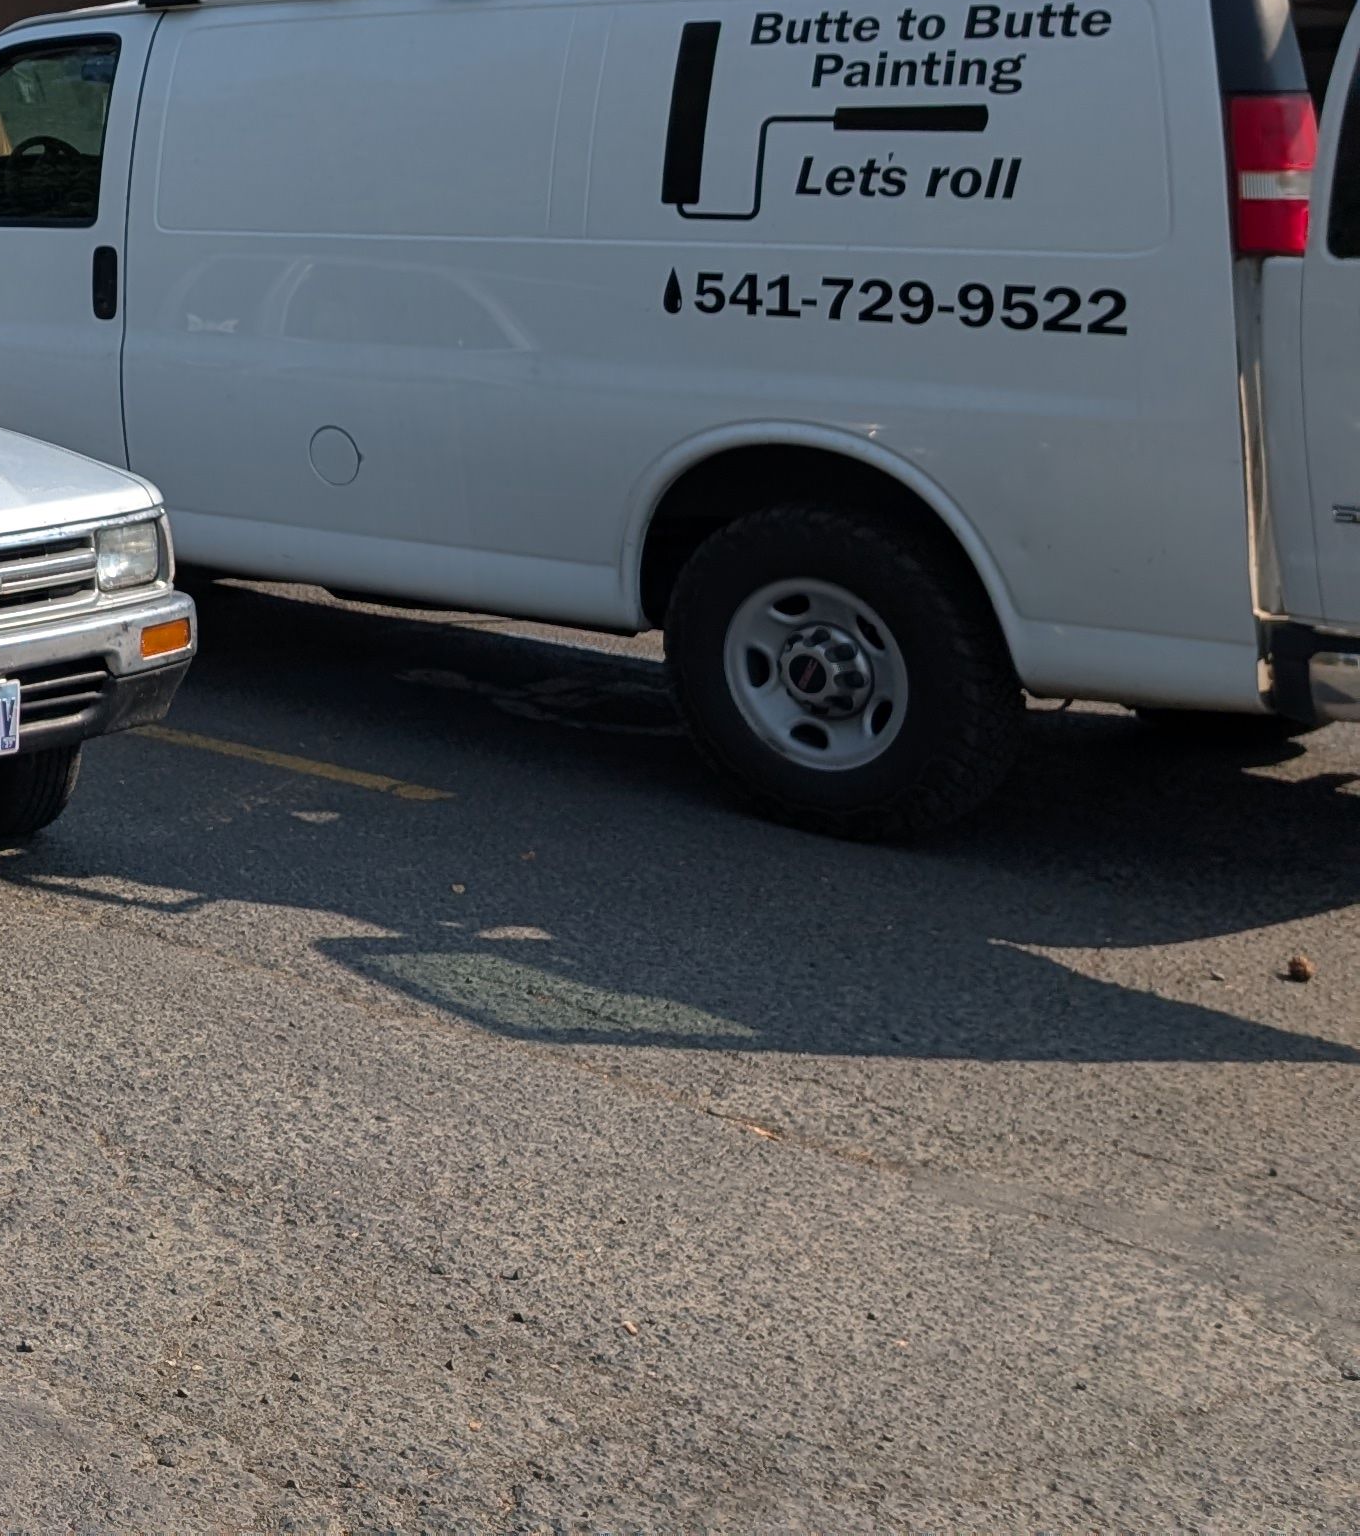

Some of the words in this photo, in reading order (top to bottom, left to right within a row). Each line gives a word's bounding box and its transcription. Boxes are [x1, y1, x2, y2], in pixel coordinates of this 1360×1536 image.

[750, 10, 880, 45] Butte
[897, 7, 946, 42] to
[963, 2, 1113, 40] Butte
[811, 49, 1027, 94] Painting
[794, 152, 908, 198] Let's
[925, 157, 1023, 199] roll
[694, 272, 1128, 336] 541-729-9522
